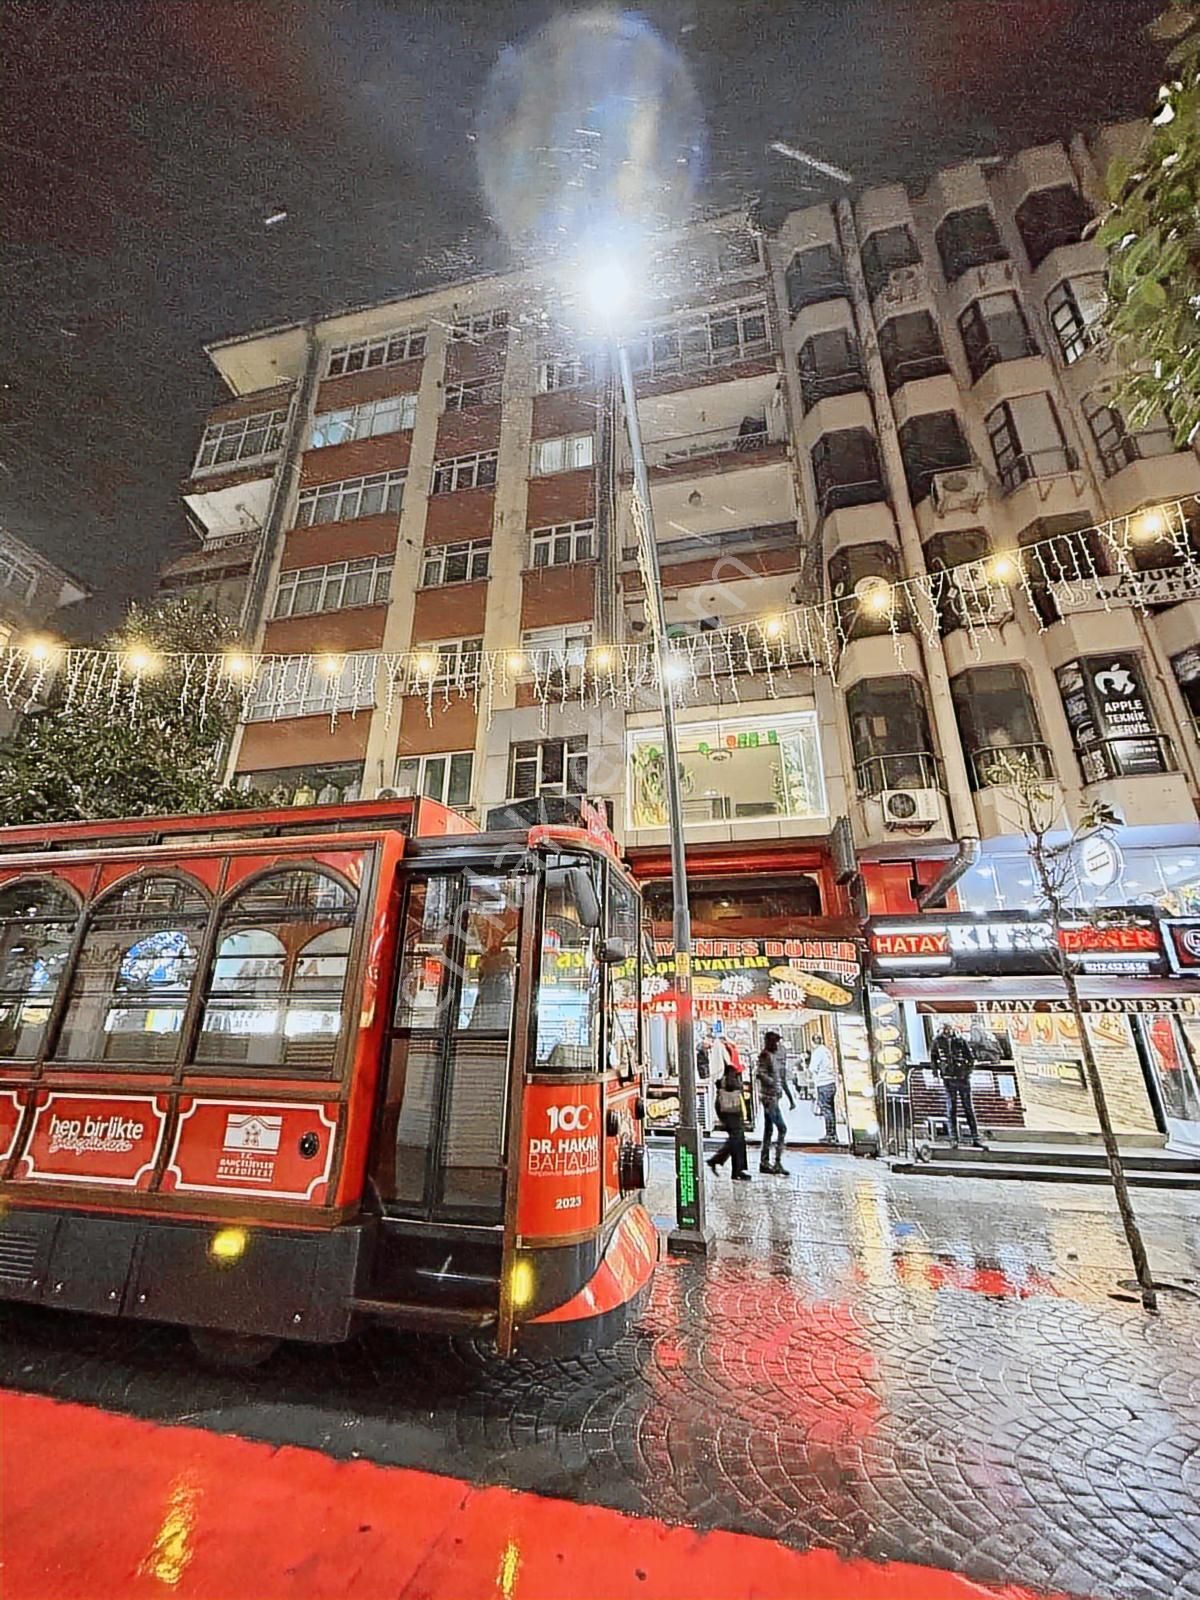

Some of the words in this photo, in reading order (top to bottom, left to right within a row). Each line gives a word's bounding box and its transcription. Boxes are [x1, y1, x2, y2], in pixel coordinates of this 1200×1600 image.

[1119, 566, 1200, 586] AVUKA
[1104, 699, 1144, 713] APPLE
[1105, 710, 1147, 724] TEKNİK
[765, 938, 857, 961] DÖNER
[876, 935, 948, 953] HATAY
[730, 980, 744, 991] 75
[777, 987, 798, 999] 100
[976, 1000, 1036, 1013] HATAY
[48, 1113, 80, 1139] hep
[83, 1115, 144, 1140] birlikte
[529, 1138, 555, 1154] DR.
[558, 1134, 599, 1153] HAKAN
[528, 1149, 599, 1171] BAHADIR
[555, 1196, 582, 1210] 2023
